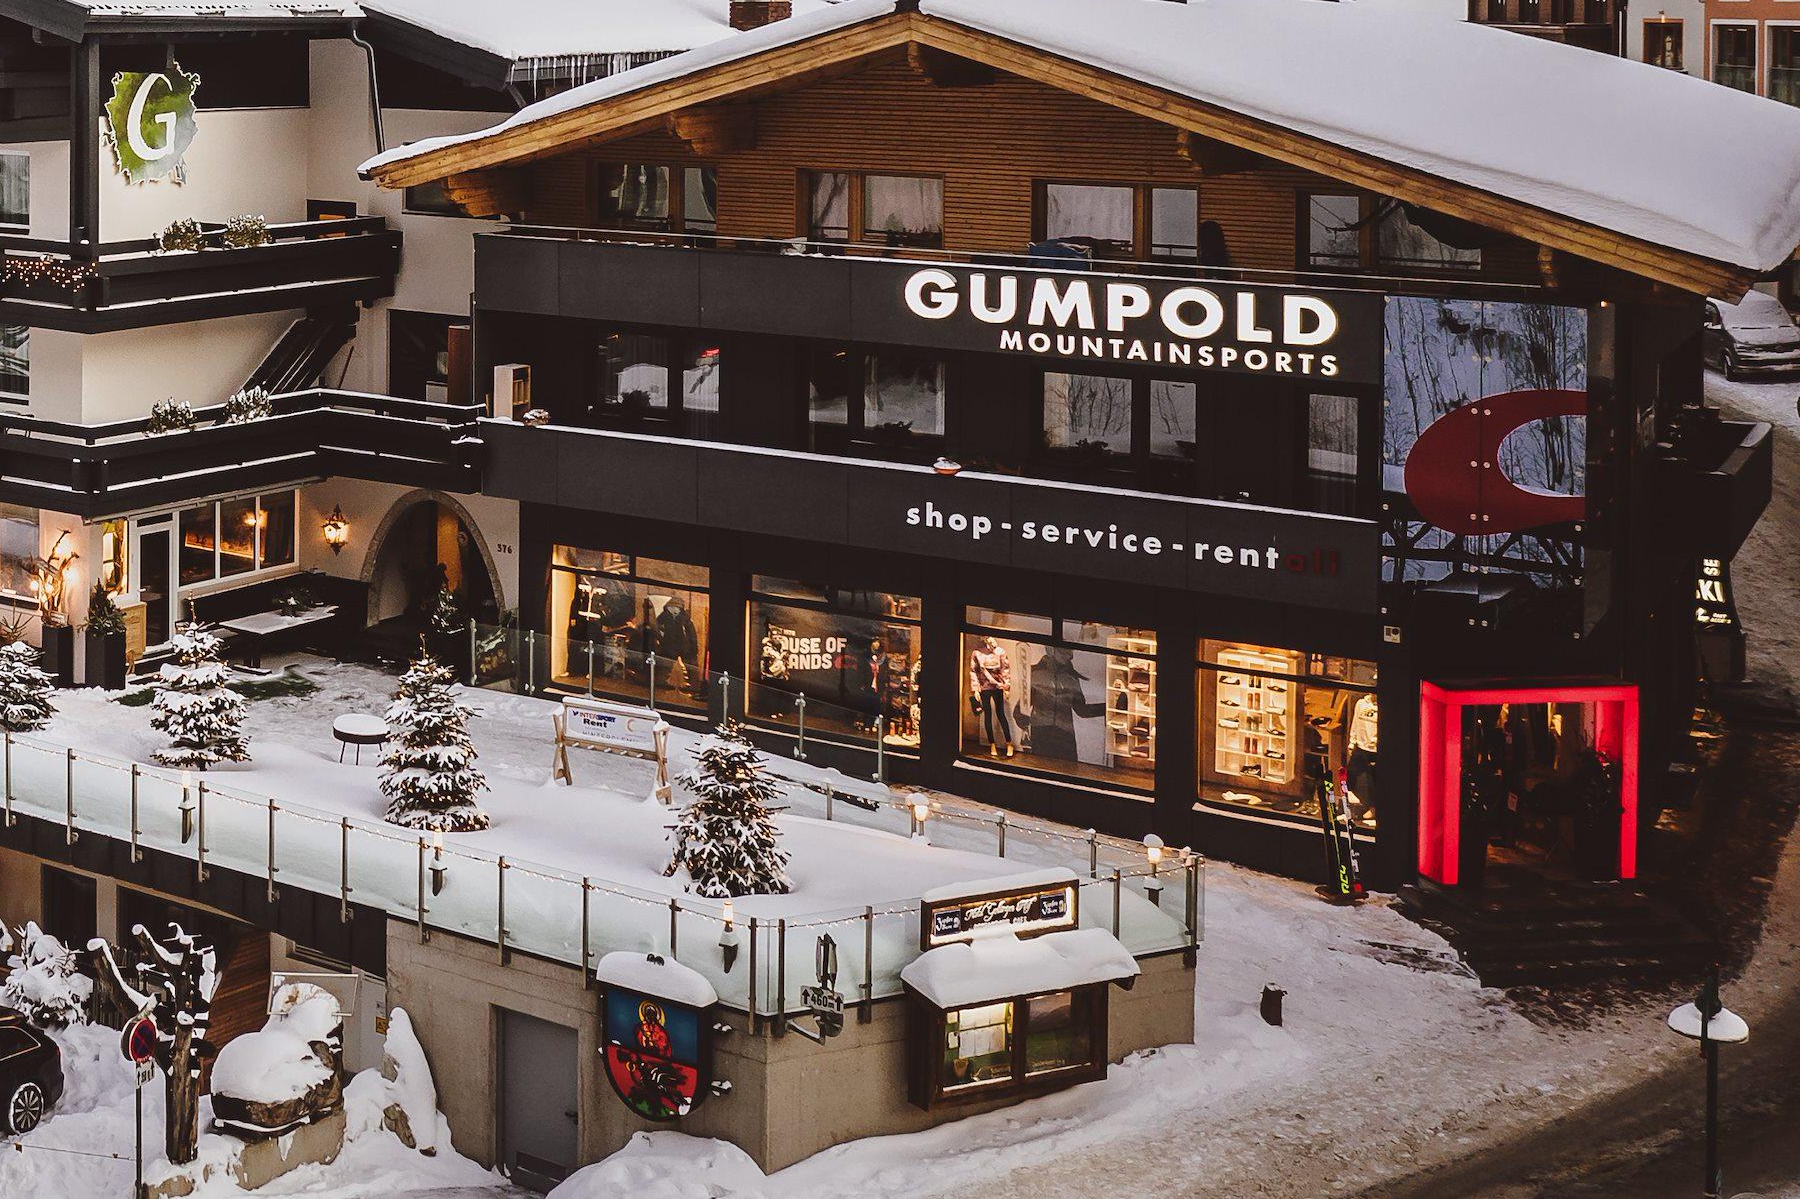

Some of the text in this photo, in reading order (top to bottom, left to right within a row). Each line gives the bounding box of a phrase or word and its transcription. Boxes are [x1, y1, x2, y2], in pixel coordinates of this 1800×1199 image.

[127, 72, 177, 161] G
[903, 268, 1339, 347] GUMPOLD
[999, 329, 1340, 377] MOUNTAINSPORTS
[906, 502, 993, 539] shop
[1022, 518, 1163, 555] service
[497, 543, 513, 554] 376
[825, 636, 848, 654] OF
[788, 653, 833, 670] ANDS
[579, 710, 616, 723] INTERSPORT
[583, 718, 608, 728] Rent
